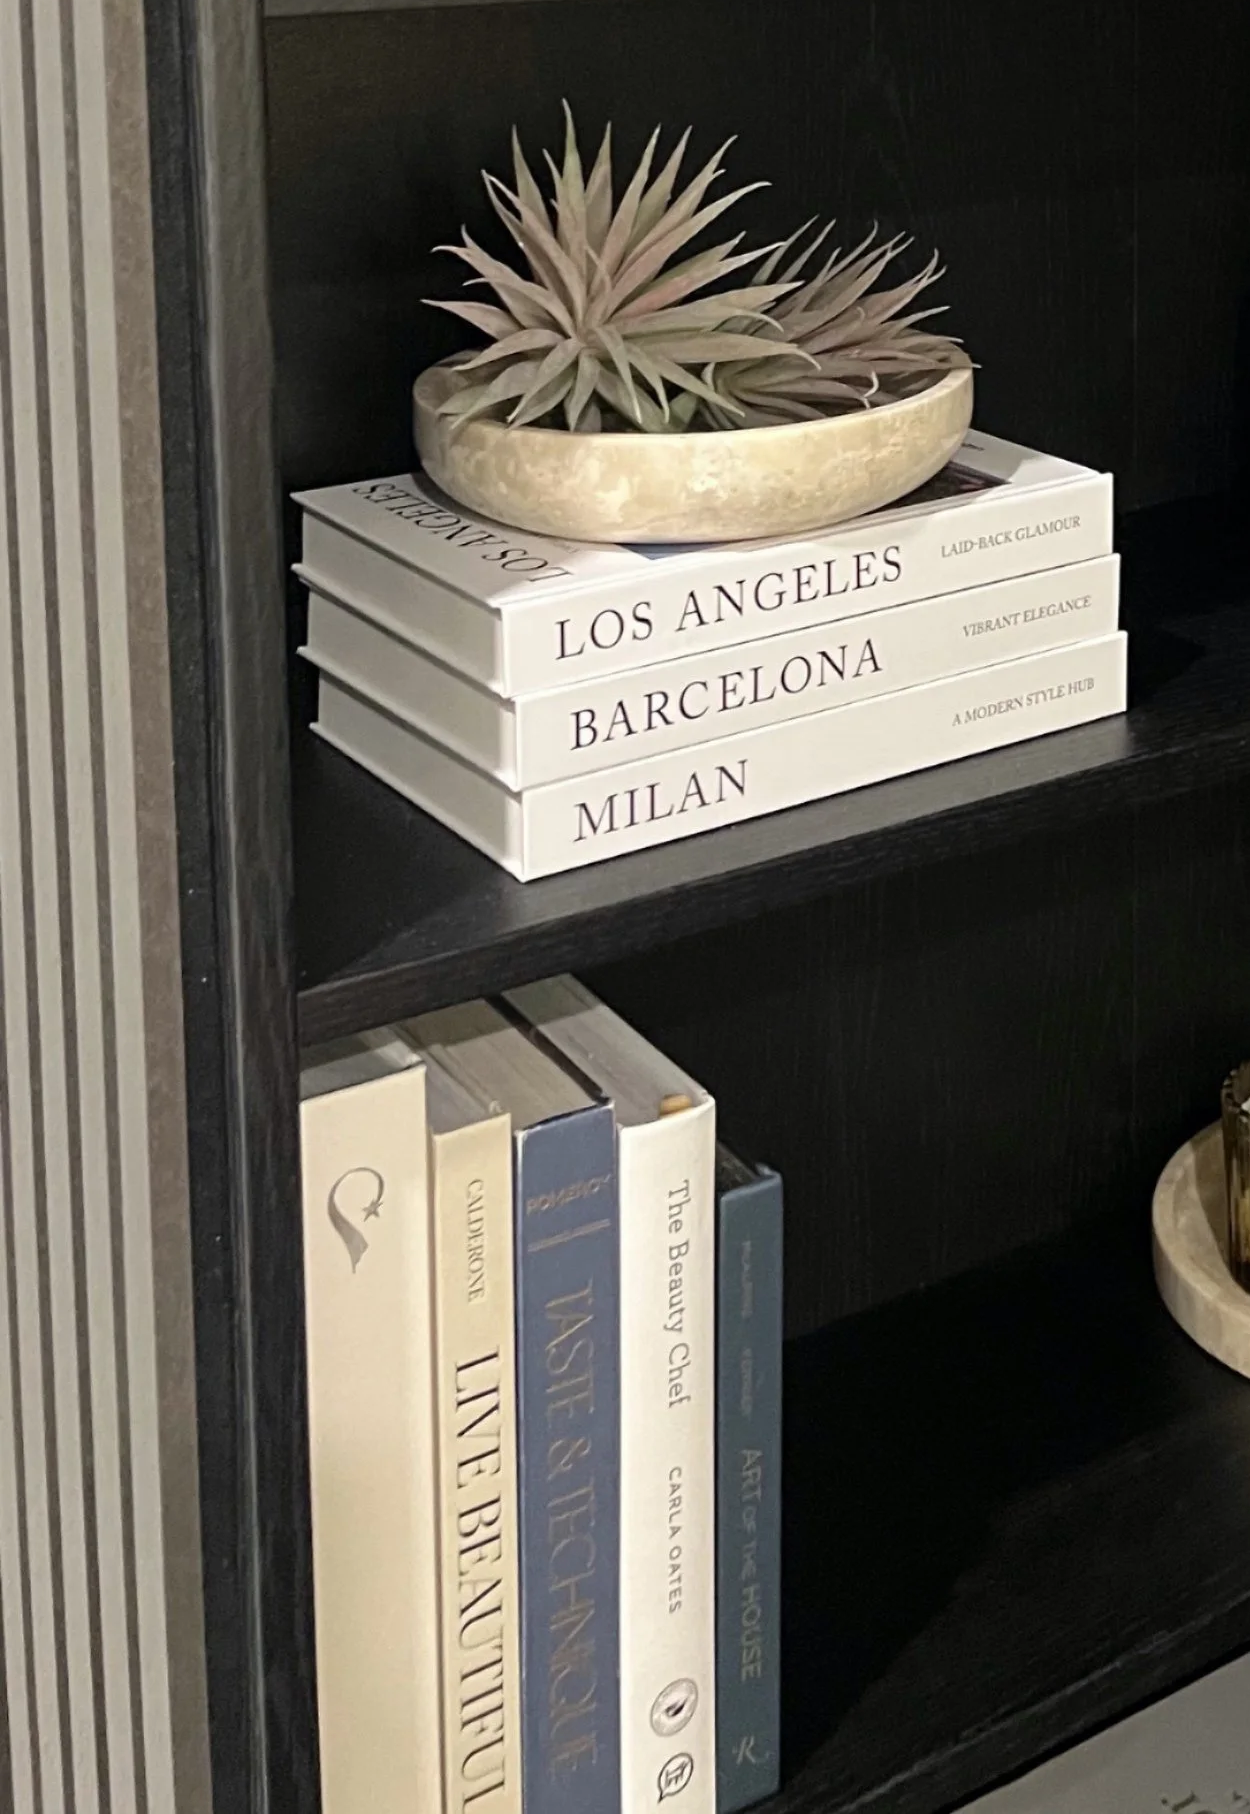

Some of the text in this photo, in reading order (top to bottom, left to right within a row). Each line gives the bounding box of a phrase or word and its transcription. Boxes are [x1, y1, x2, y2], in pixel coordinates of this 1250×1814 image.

[352, 482, 574, 583] LOS ANGELES
[555, 514, 1082, 661] LOS ANGELES LAID-BACK GLAMOUR
[569, 594, 1093, 751] BARCELONA VIBRANT ELEGANCE
[572, 676, 1096, 843] MILAN A MODERN STYLE HUB
[466, 1178, 486, 1304] CALDERONE
[662, 1178, 692, 1409] The Beauty Chef
[545, 1274, 598, 1782] TASTE & TECHNIQUE
[668, 1465, 683, 1616] CARLA OATES
[740, 1448, 765, 1503] ART
[455, 1345, 506, 1814] LIVE BEAUTIFUL
[740, 1584, 763, 1681] HOUSE
